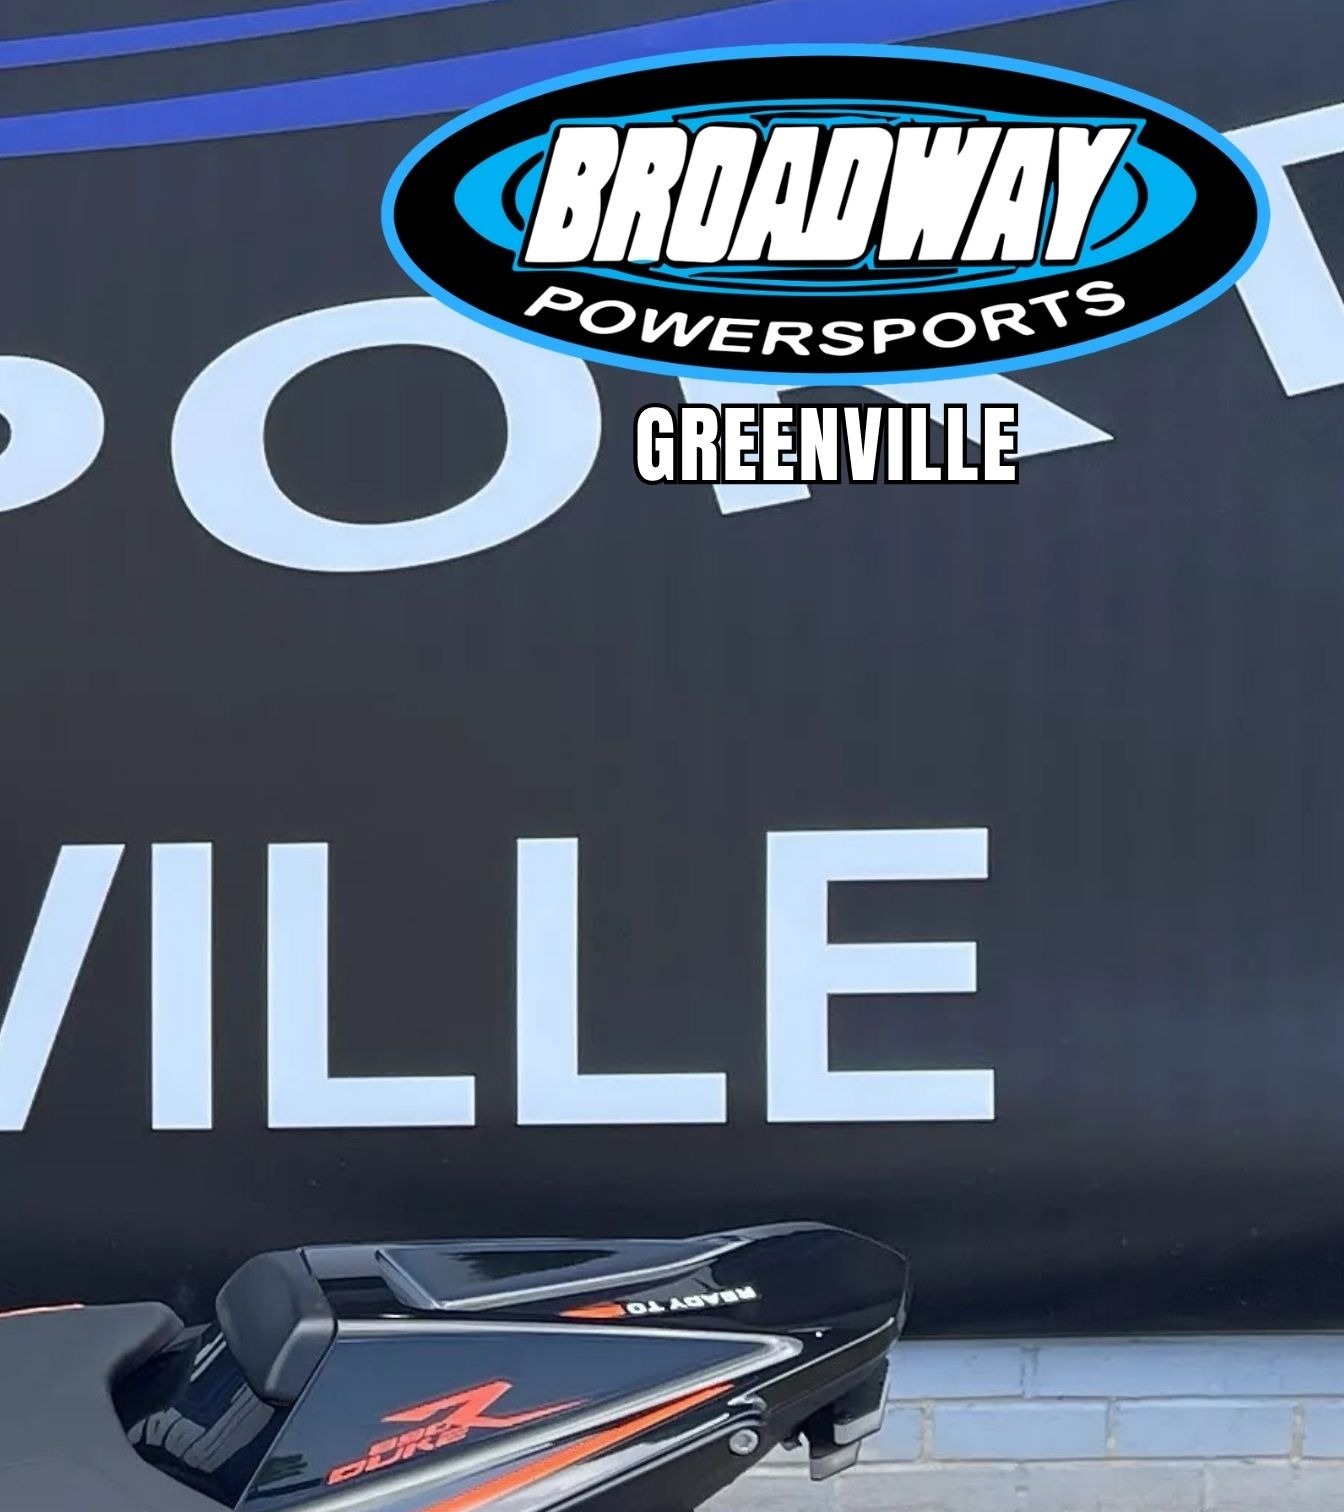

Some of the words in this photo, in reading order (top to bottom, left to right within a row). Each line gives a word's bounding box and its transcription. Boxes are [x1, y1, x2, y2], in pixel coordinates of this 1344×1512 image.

[626, 1301, 666, 1315] TO
[669, 1285, 757, 1311] READY
[327, 1426, 471, 1485] DUKE
